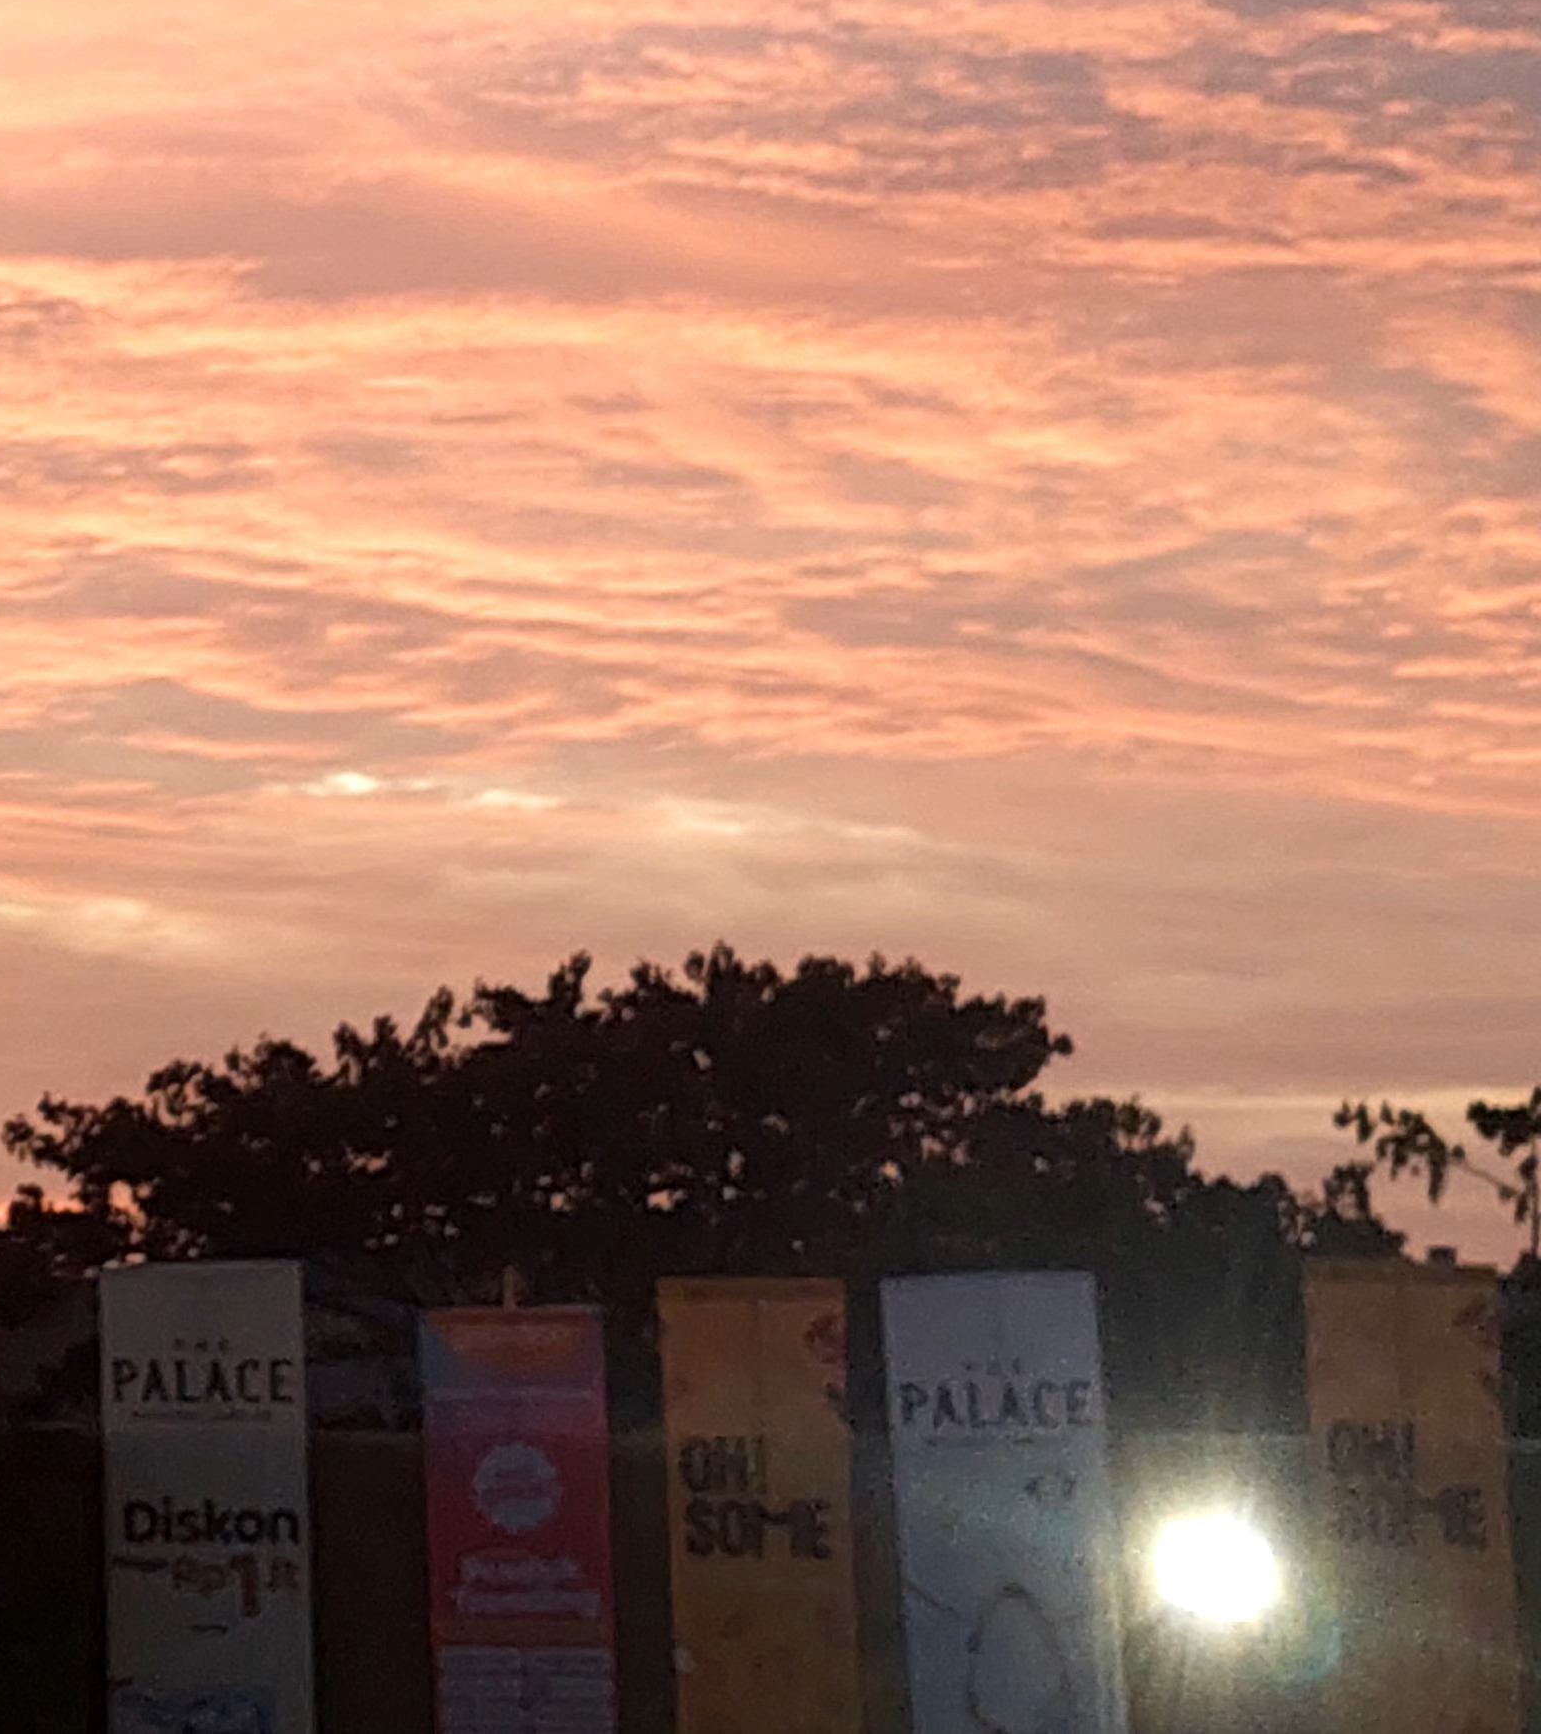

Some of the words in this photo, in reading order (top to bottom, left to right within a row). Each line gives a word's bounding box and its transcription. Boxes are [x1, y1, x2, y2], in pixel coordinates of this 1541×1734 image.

[112, 1357, 294, 1403] PALACE
[899, 1379, 1092, 1428] PALACE
[123, 1496, 300, 1544] Diskon
